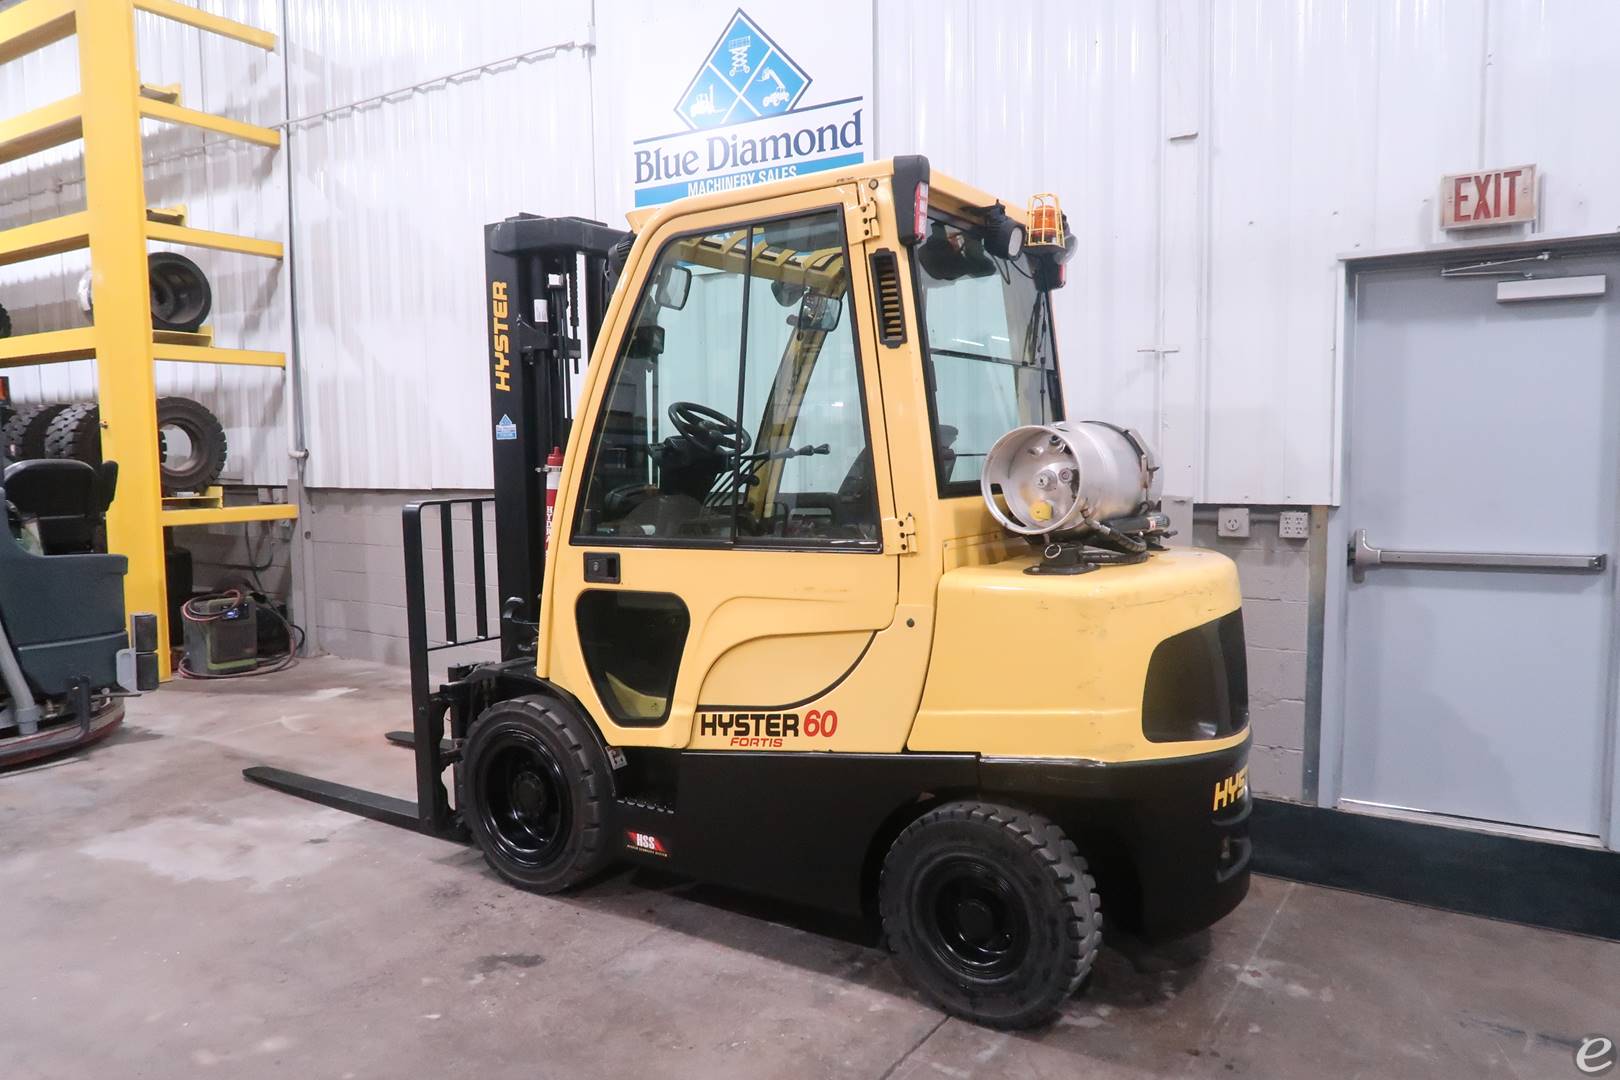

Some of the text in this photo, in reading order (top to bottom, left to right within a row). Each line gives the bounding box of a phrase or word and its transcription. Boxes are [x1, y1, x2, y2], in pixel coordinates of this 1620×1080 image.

[634, 108, 863, 184] Blue Diamond
[687, 165, 797, 198] MACHINERY SALES
[1453, 170, 1522, 222] EXIT
[492, 281, 511, 392] HYSTER
[700, 709, 838, 738] HYSTER 60
[730, 737, 784, 748] FORTIS
[636, 833, 655, 850] HSS
